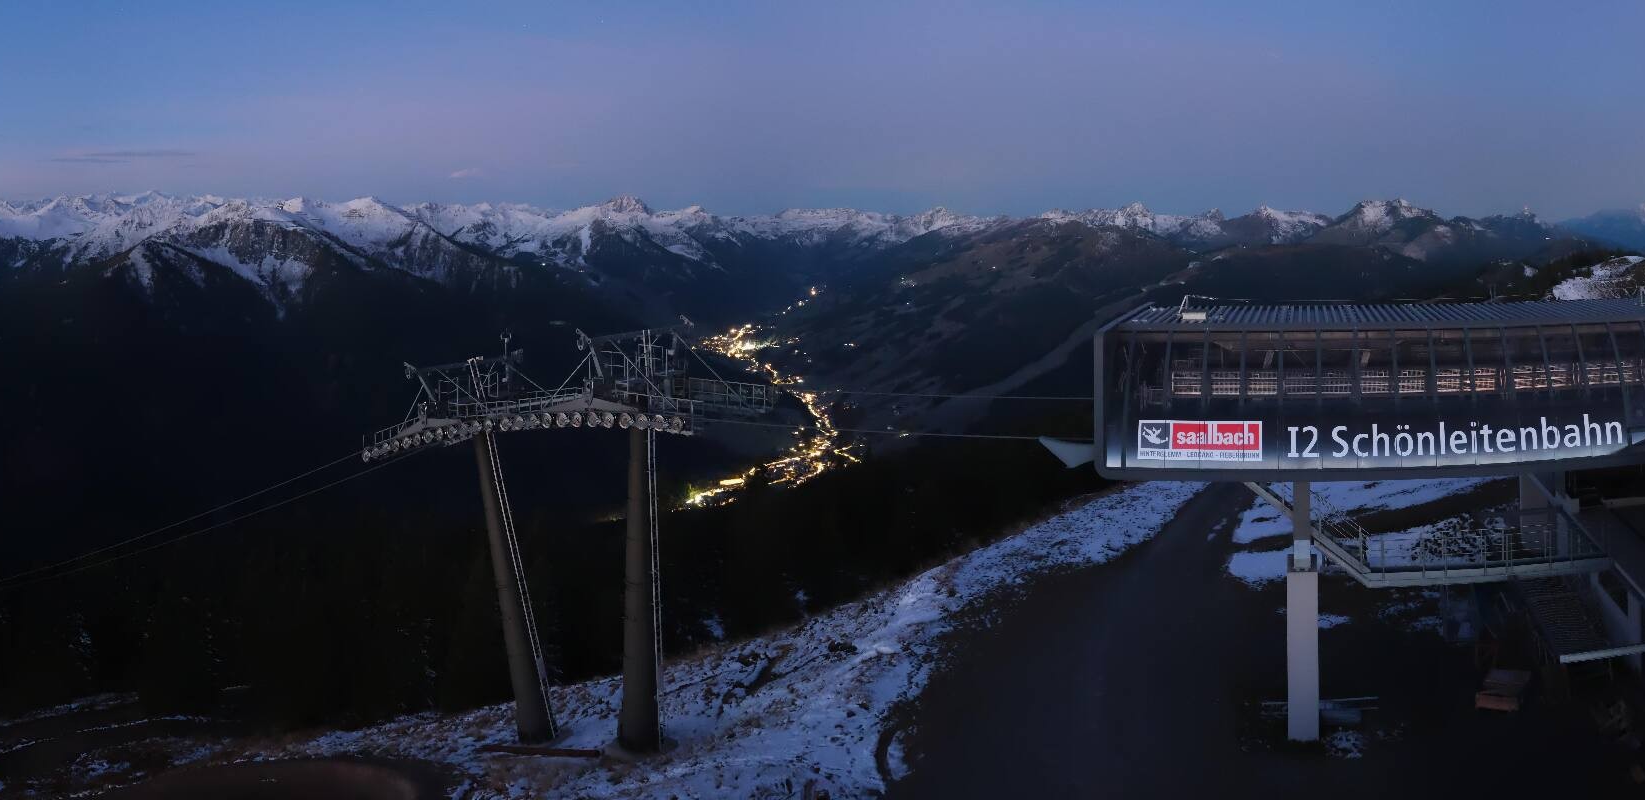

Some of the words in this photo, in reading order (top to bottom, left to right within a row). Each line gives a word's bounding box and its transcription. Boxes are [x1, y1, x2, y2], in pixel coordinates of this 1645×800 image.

[1176, 421, 1255, 446] saalbach
[1287, 425, 1320, 458] I2
[1331, 414, 1624, 458] Schönleitenbahn
